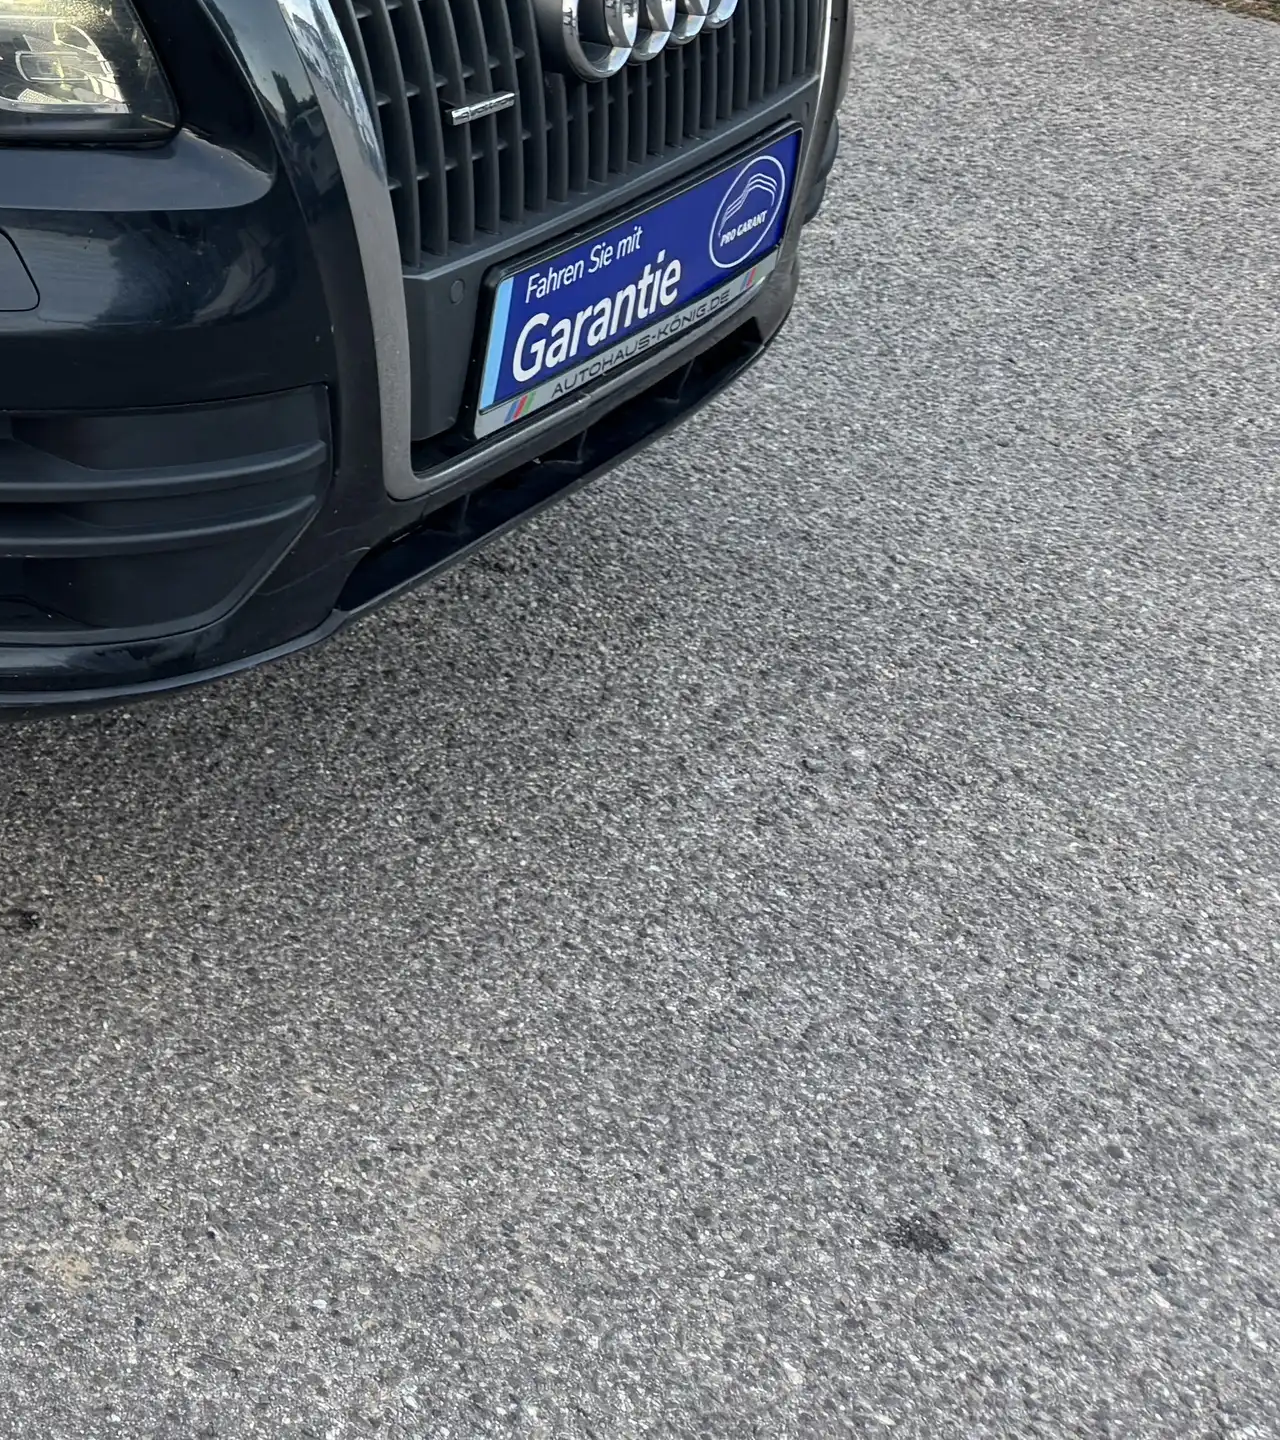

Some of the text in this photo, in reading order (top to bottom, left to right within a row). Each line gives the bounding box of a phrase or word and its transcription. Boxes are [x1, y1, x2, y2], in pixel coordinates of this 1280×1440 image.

[525, 225, 643, 304] Fahren Sie mit
[720, 210, 768, 248] PRO GARANT
[513, 249, 682, 382] Garantie
[551, 288, 731, 398] AUTOHAUS-KÖNIG.DE
